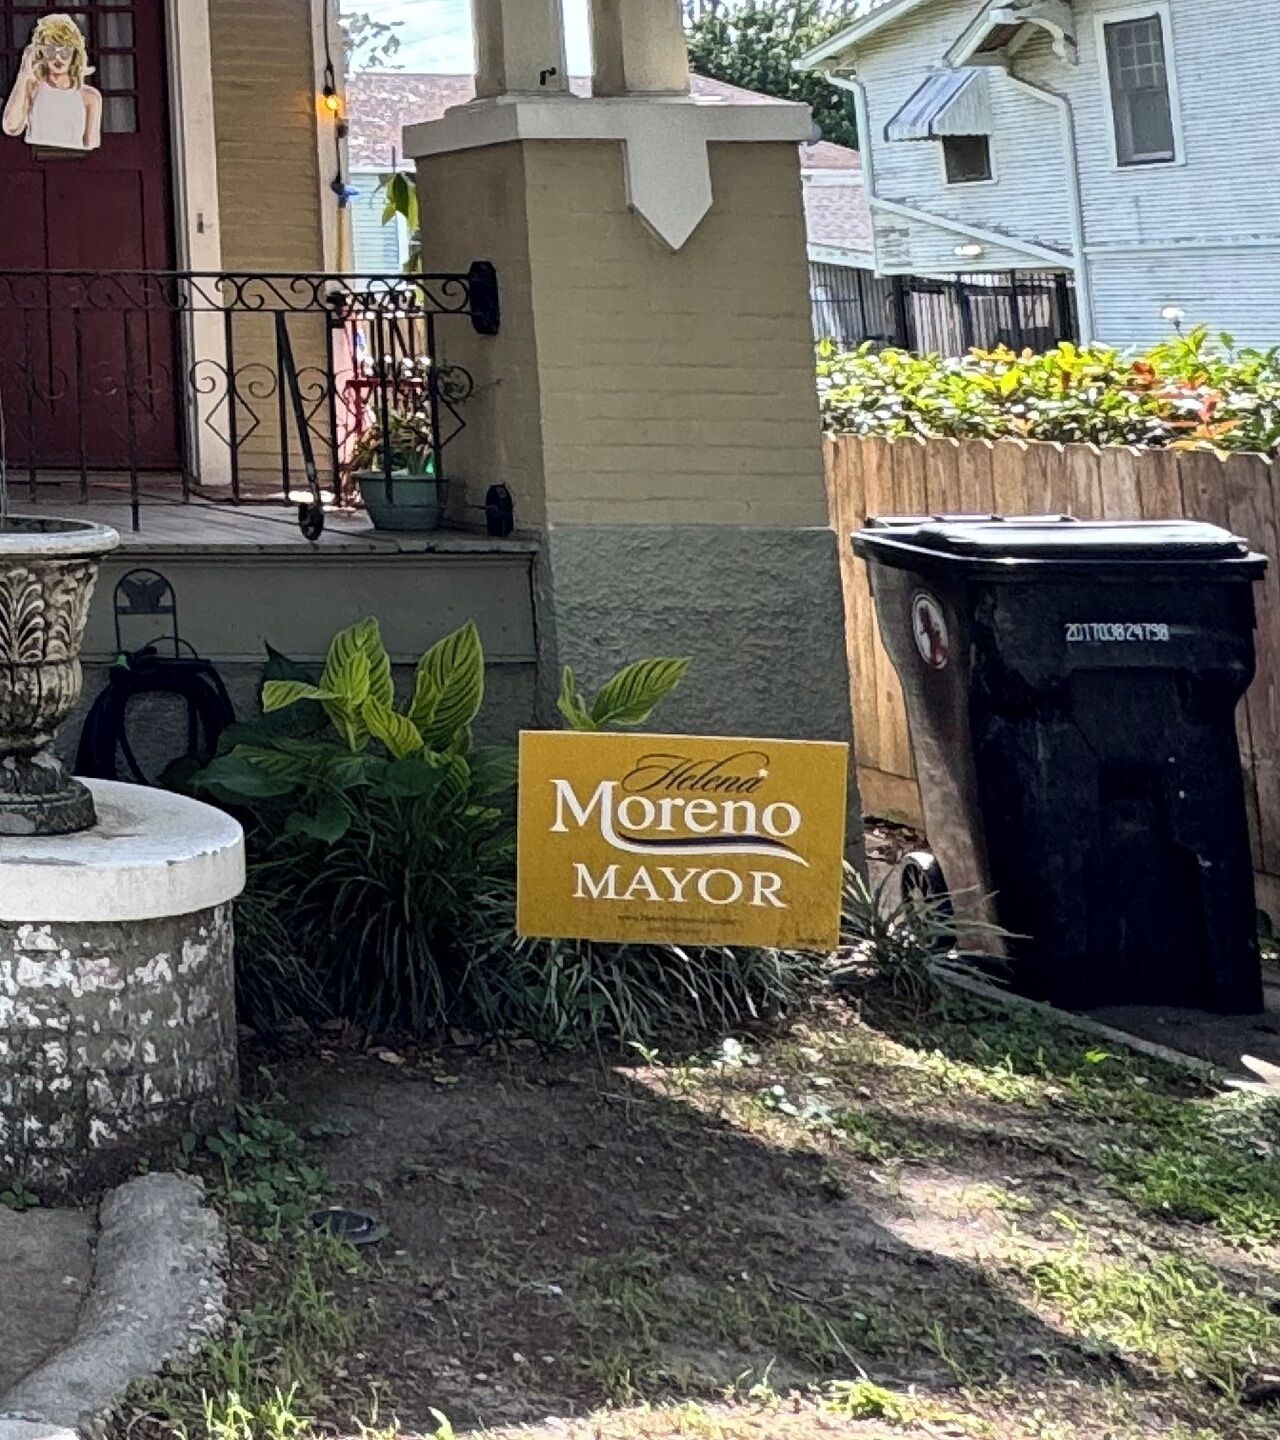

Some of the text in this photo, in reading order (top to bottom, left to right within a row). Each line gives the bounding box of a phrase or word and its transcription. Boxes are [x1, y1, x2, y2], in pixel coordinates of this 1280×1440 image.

[621, 750, 771, 794] Helena
[549, 779, 804, 841] Moreno
[572, 862, 788, 909] MAYOR
